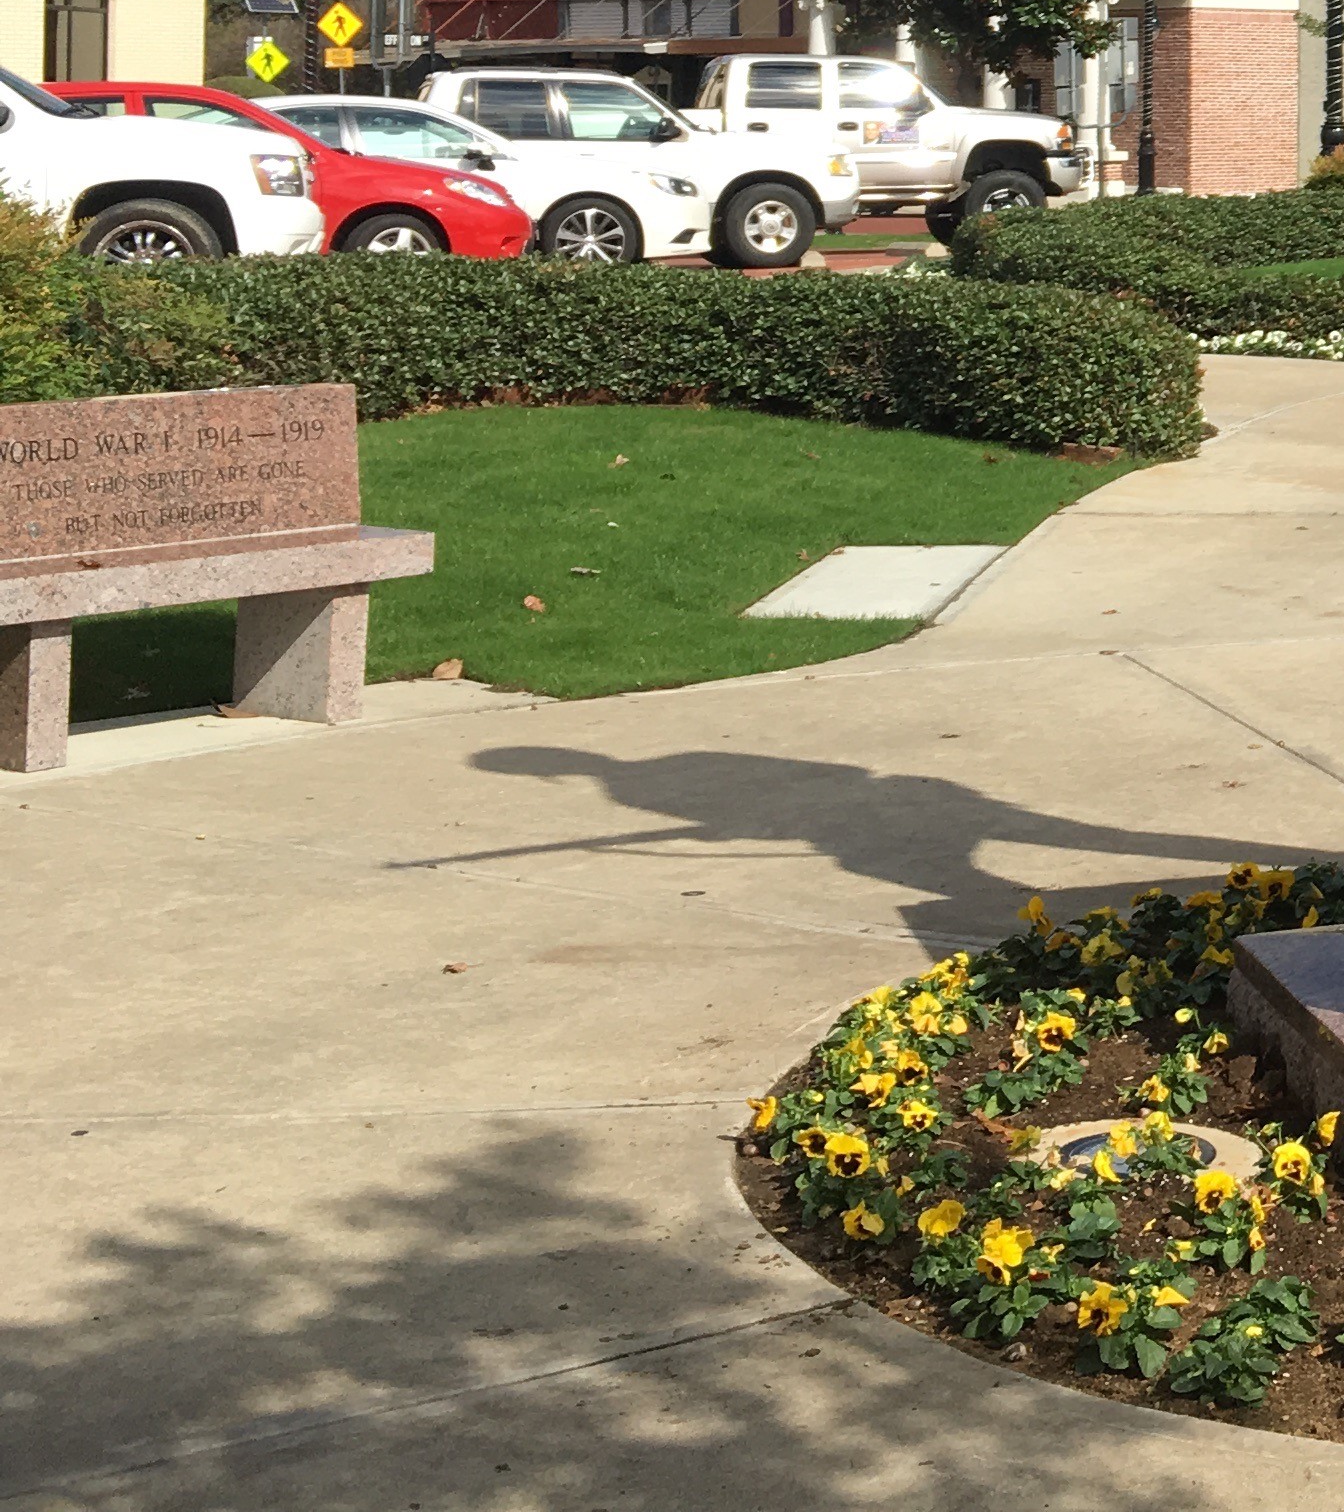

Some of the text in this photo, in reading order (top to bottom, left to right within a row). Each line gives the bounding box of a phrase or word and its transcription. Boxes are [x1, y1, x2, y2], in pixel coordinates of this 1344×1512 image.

[94, 431, 148, 456] WAR
[12, 461, 307, 502] THOSE WHO SERVED ARE GONE
[65, 499, 263, 535] BUT NOT FORGOTTEN
